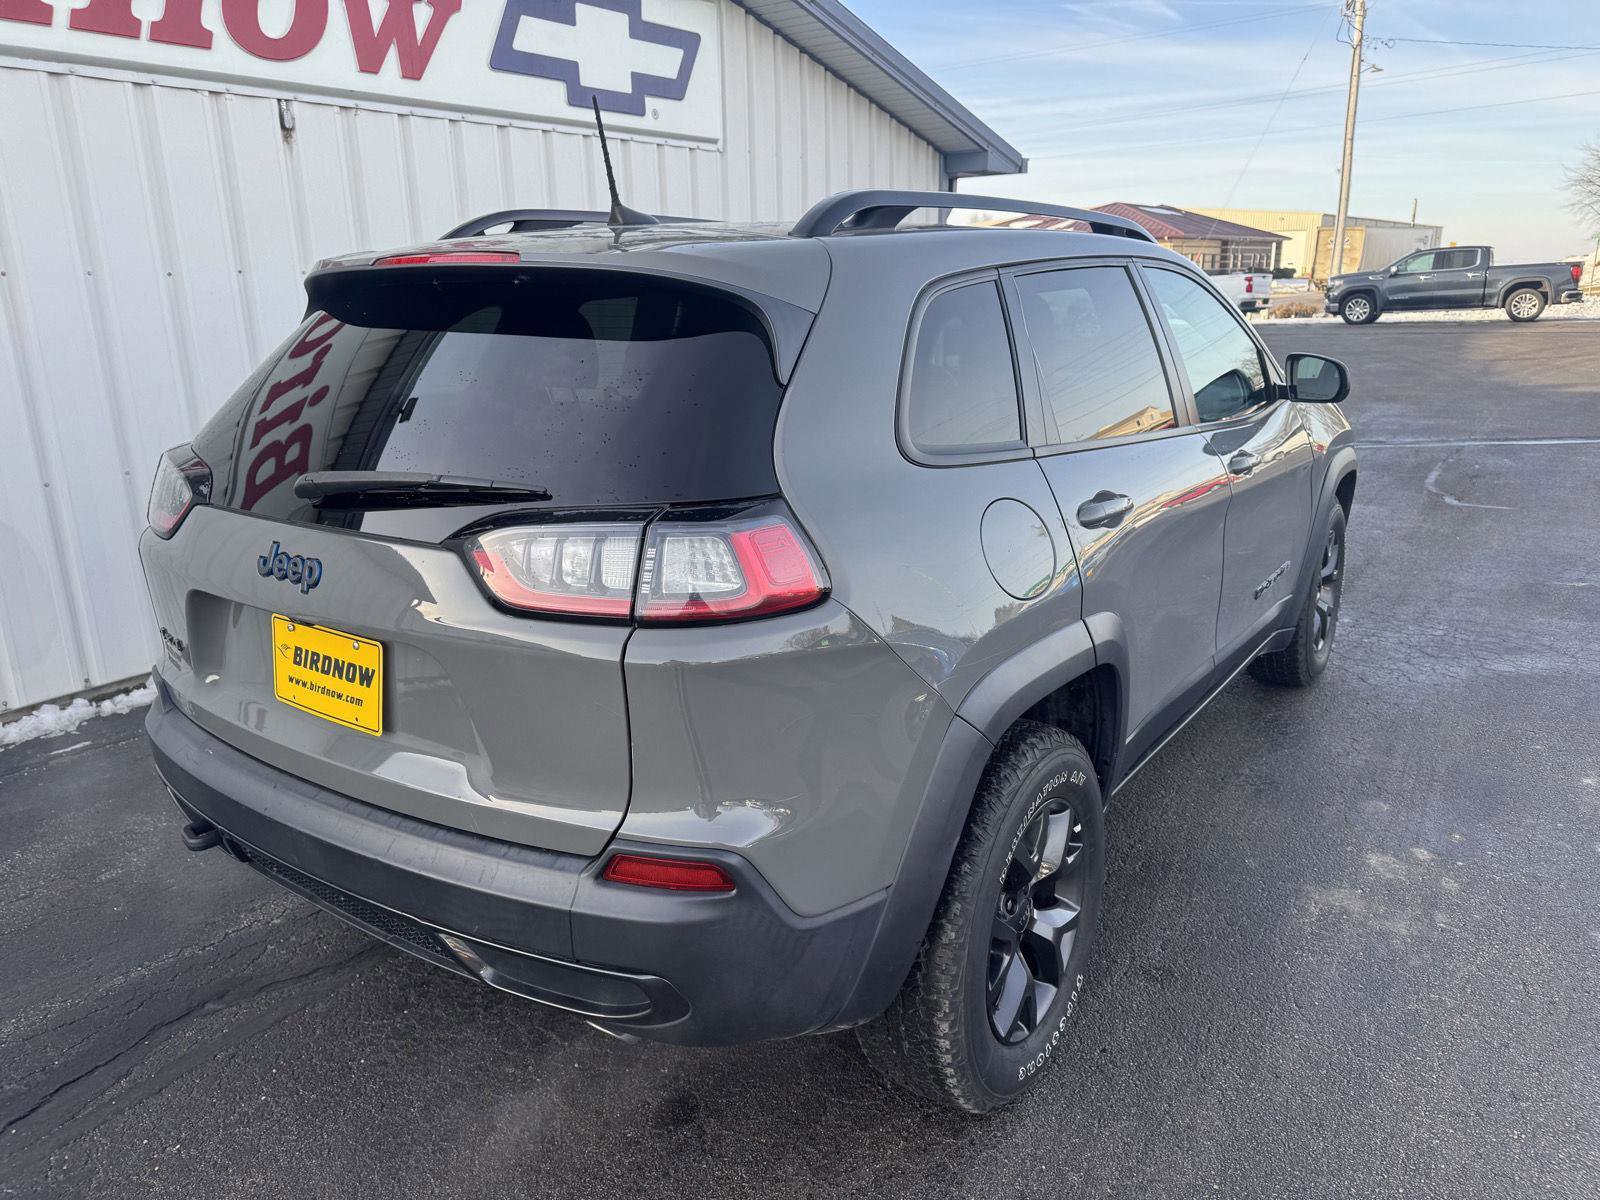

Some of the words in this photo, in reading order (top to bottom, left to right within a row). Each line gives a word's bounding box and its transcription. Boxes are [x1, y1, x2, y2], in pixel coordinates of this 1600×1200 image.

[257, 541, 322, 594] Jeep
[292, 645, 376, 689] BIRDNOW
[287, 674, 364, 707] www.birdnow.com
